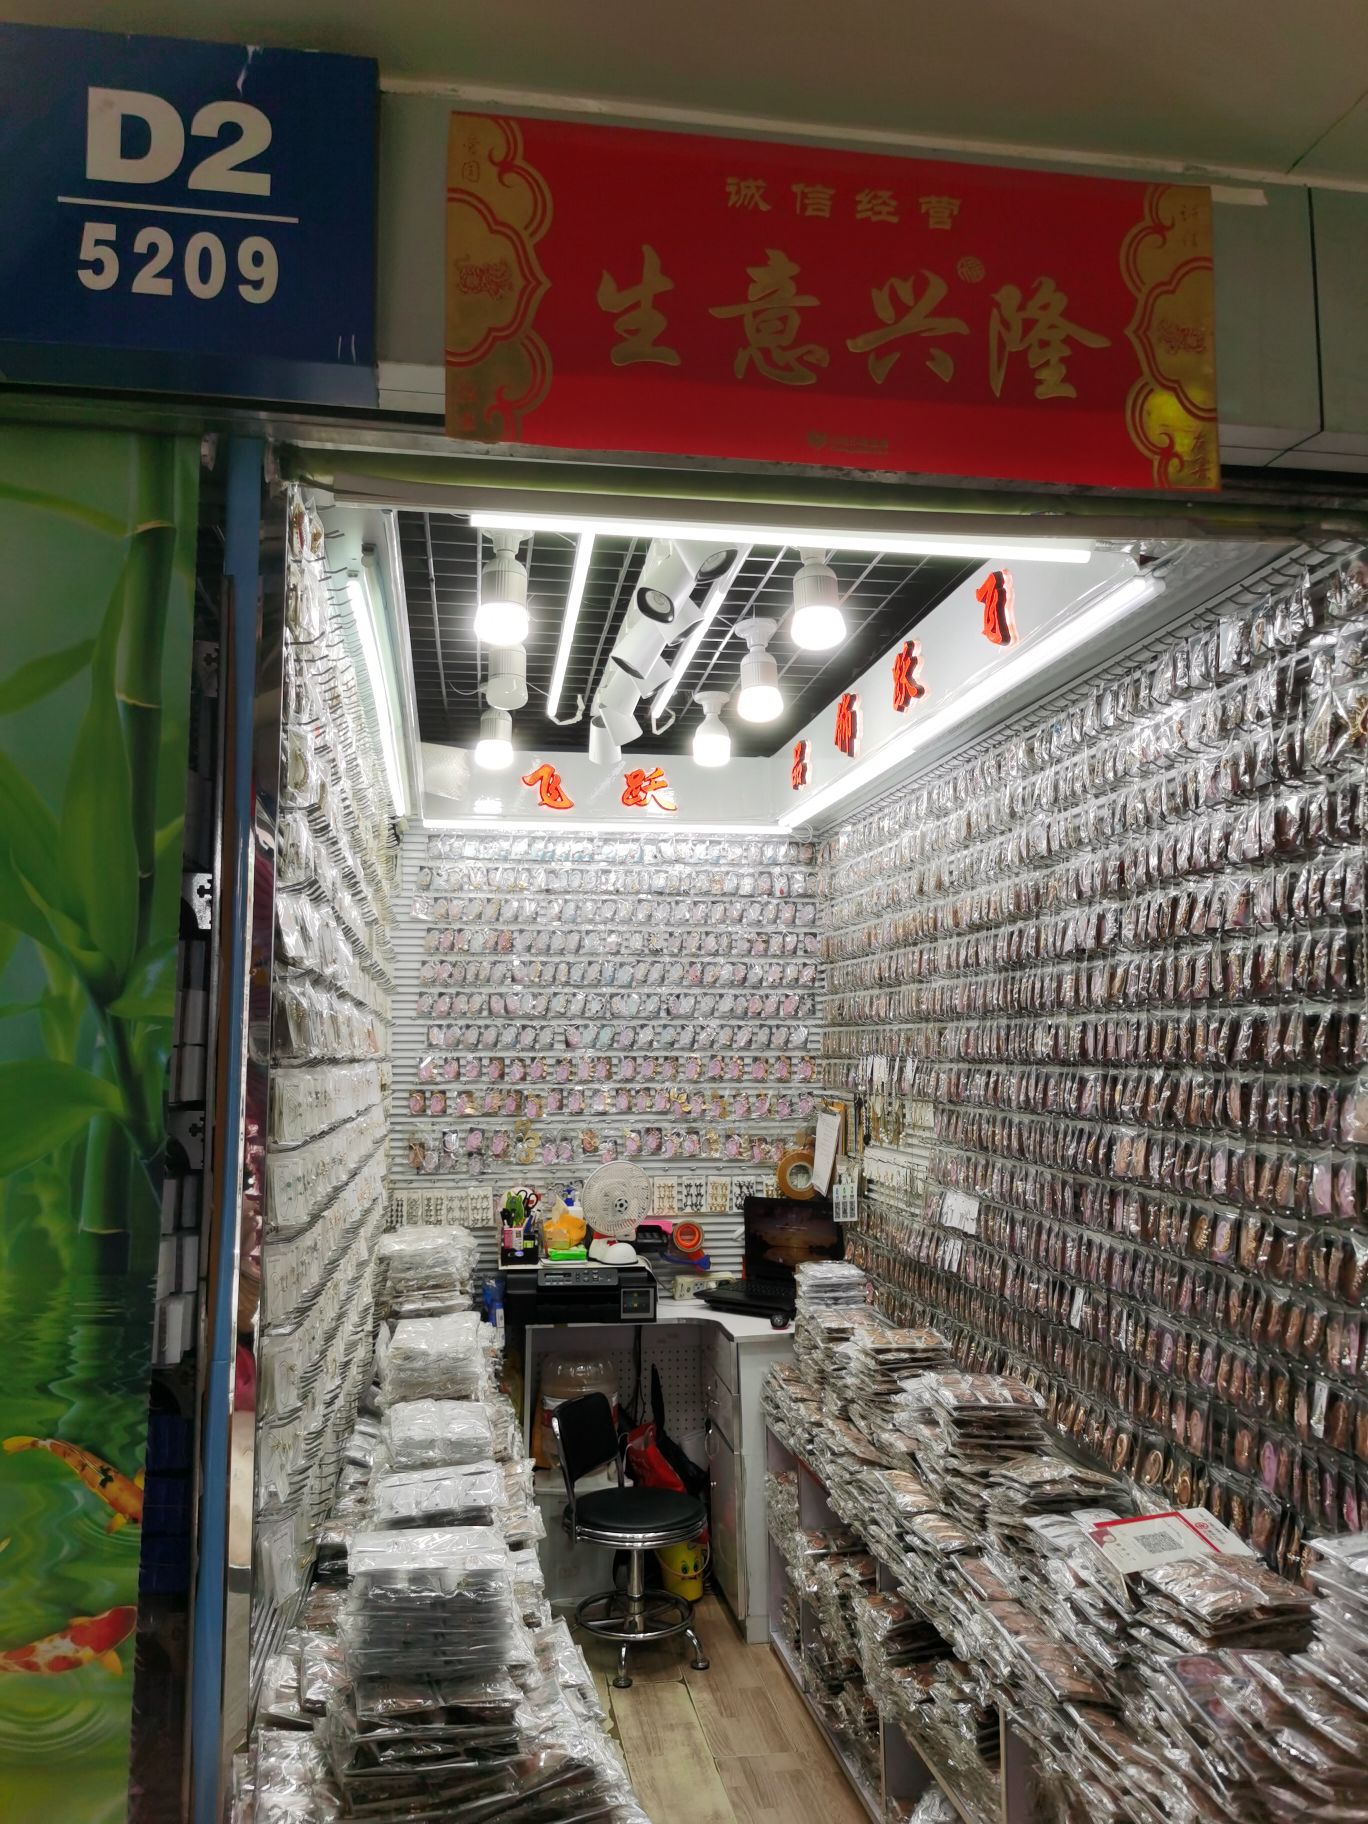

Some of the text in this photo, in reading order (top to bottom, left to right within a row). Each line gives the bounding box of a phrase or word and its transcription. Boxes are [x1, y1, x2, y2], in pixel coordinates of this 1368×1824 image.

[86, 86, 273, 197] D2
[725, 175, 962, 231] 诚信经营
[76, 221, 280, 304] 5209
[596, 243, 1111, 400] 生意兴隆
[521, 763, 678, 812] 飞跃
